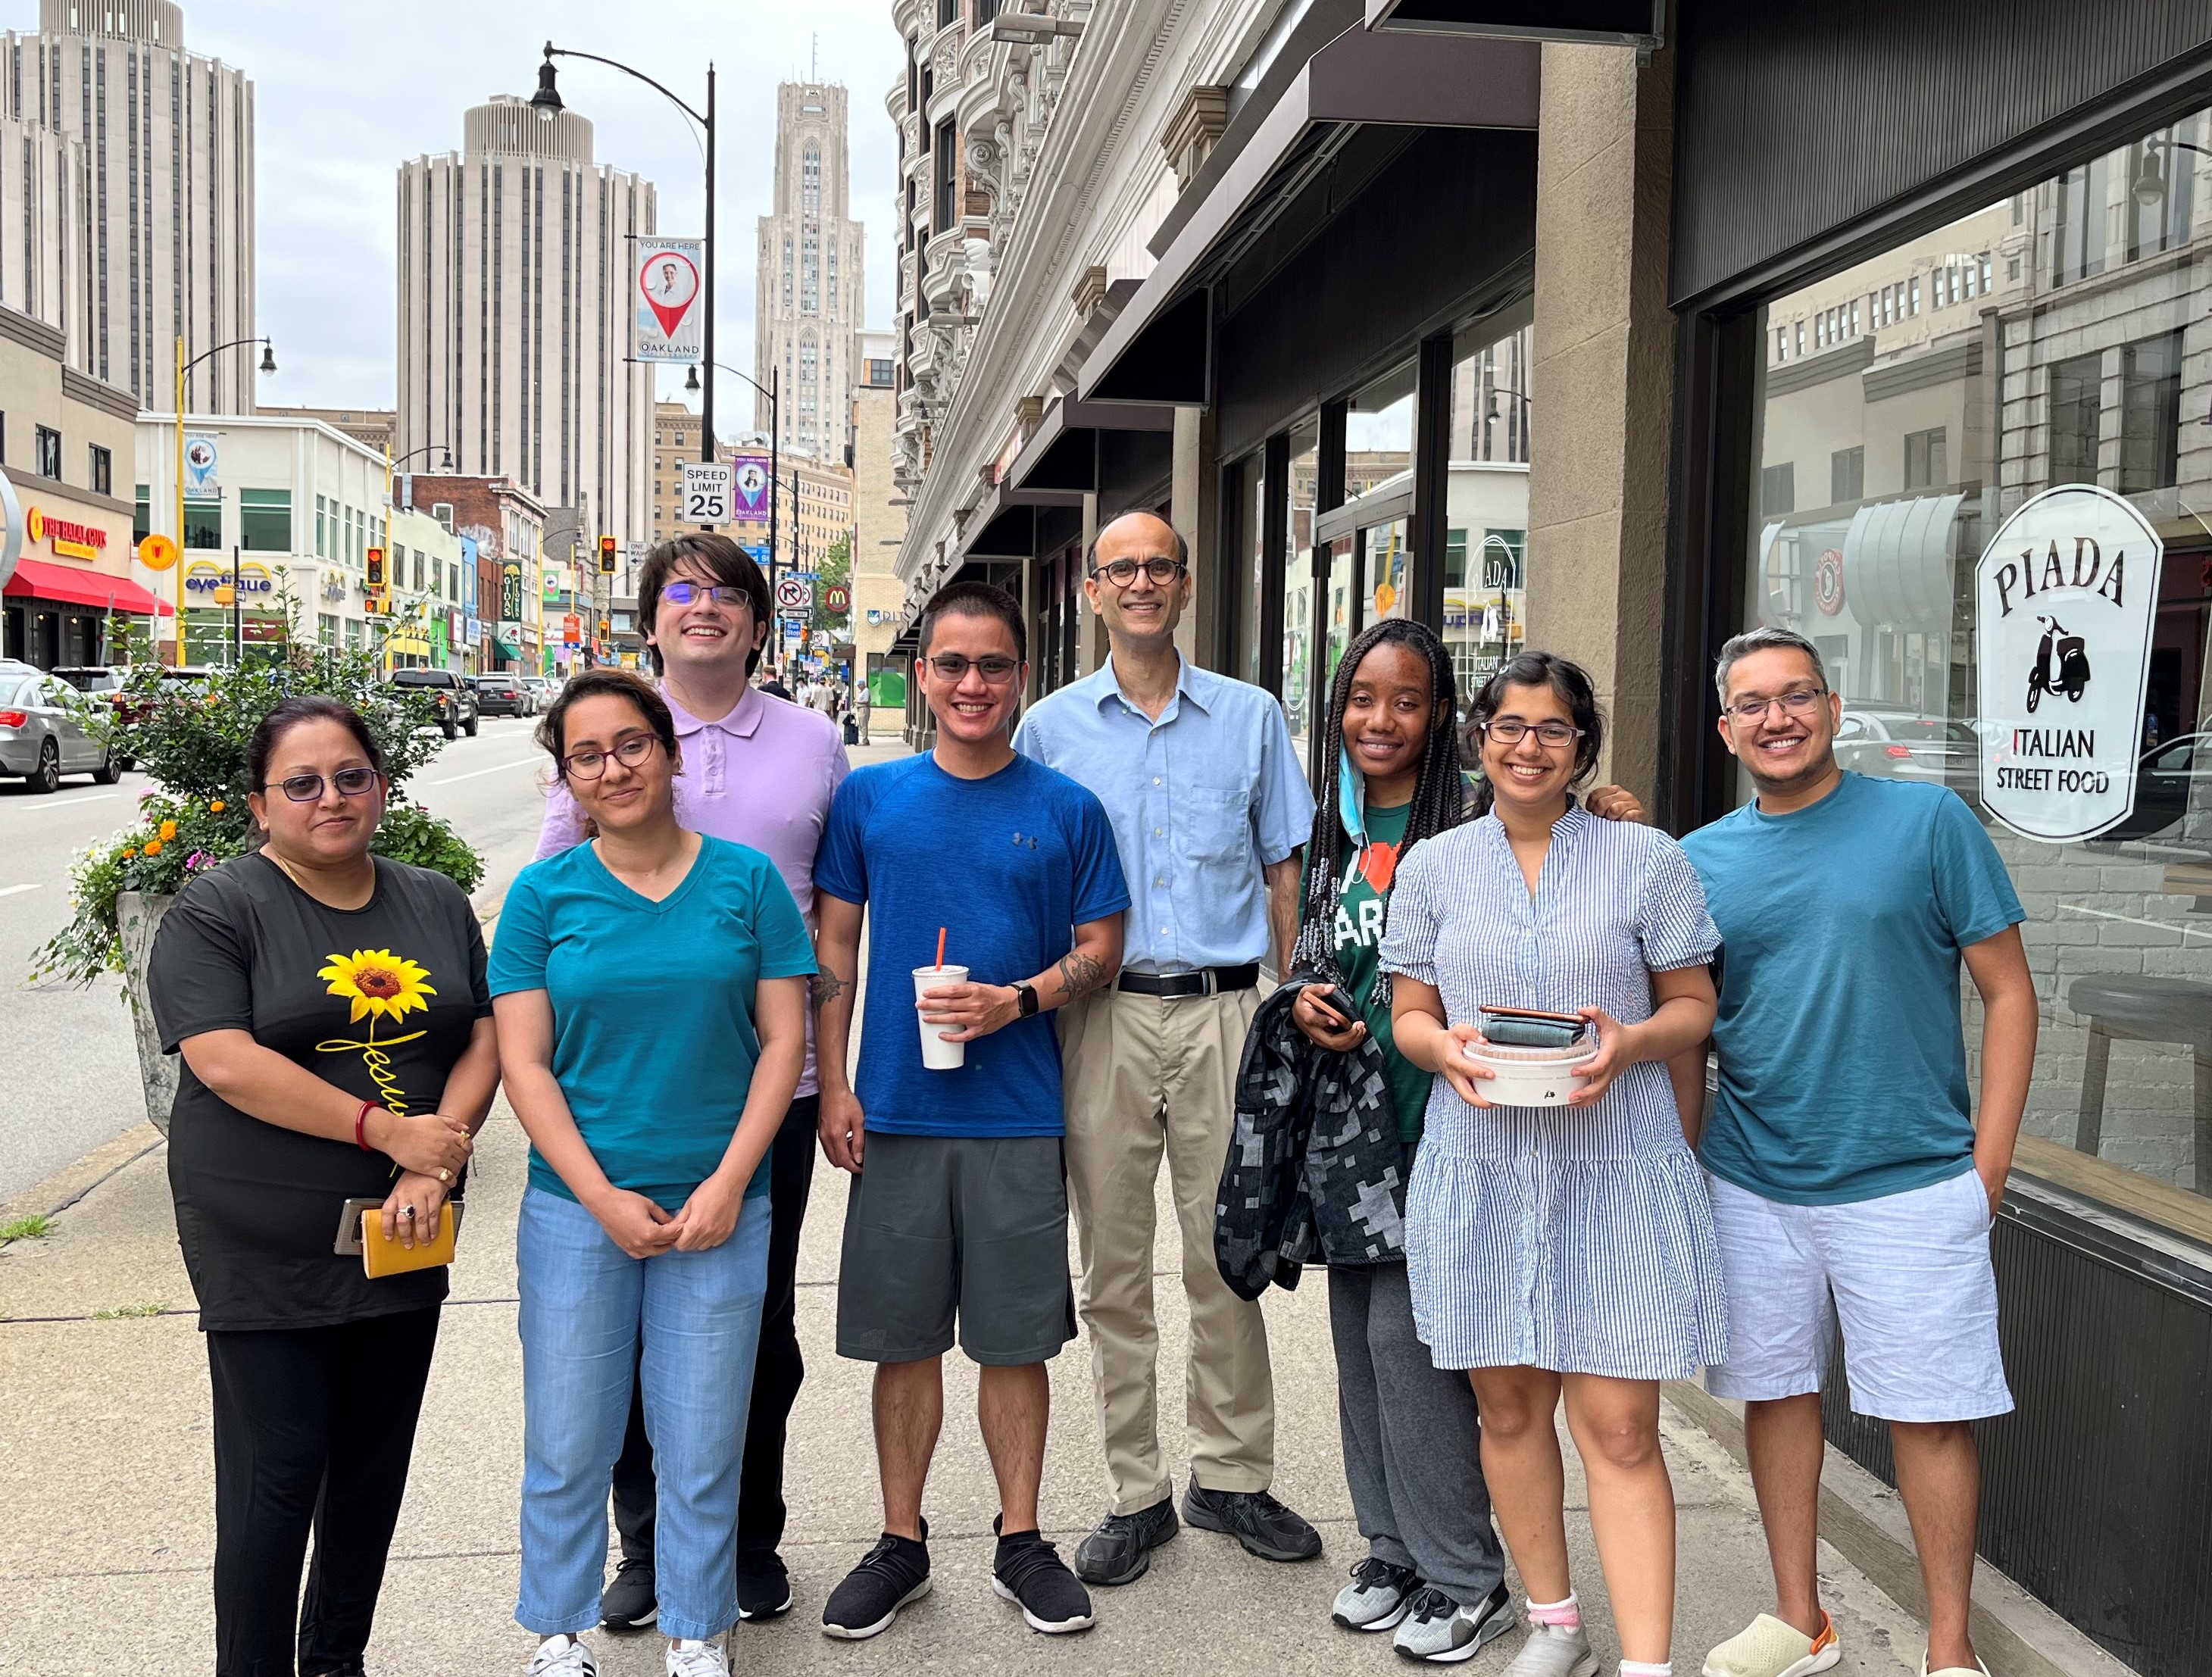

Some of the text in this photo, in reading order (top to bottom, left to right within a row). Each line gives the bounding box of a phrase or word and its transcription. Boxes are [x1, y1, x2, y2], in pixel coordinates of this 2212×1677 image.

[640, 241, 658, 249] YOU
[678, 242, 700, 251] HERE
[640, 343, 699, 354] OAKLAND
[687, 470, 727, 480] SPEED
[692, 482, 723, 492] LIMIT
[689, 495, 723, 517] 25
[43, 516, 107, 548] THE HALAL GUYS
[1472, 561, 1507, 600] PIADA
[1993, 536, 2124, 618] PIADA
[503, 576, 511, 617] GIDAS
[883, 611, 904, 620] RIT
[1476, 656, 1498, 670] ITALIAN
[2013, 729, 2095, 758] ITALIAN
[1996, 767, 2110, 794] STREET FOOD
[1333, 898, 1389, 951] AR
[315, 1030, 428, 1117] Jesu
